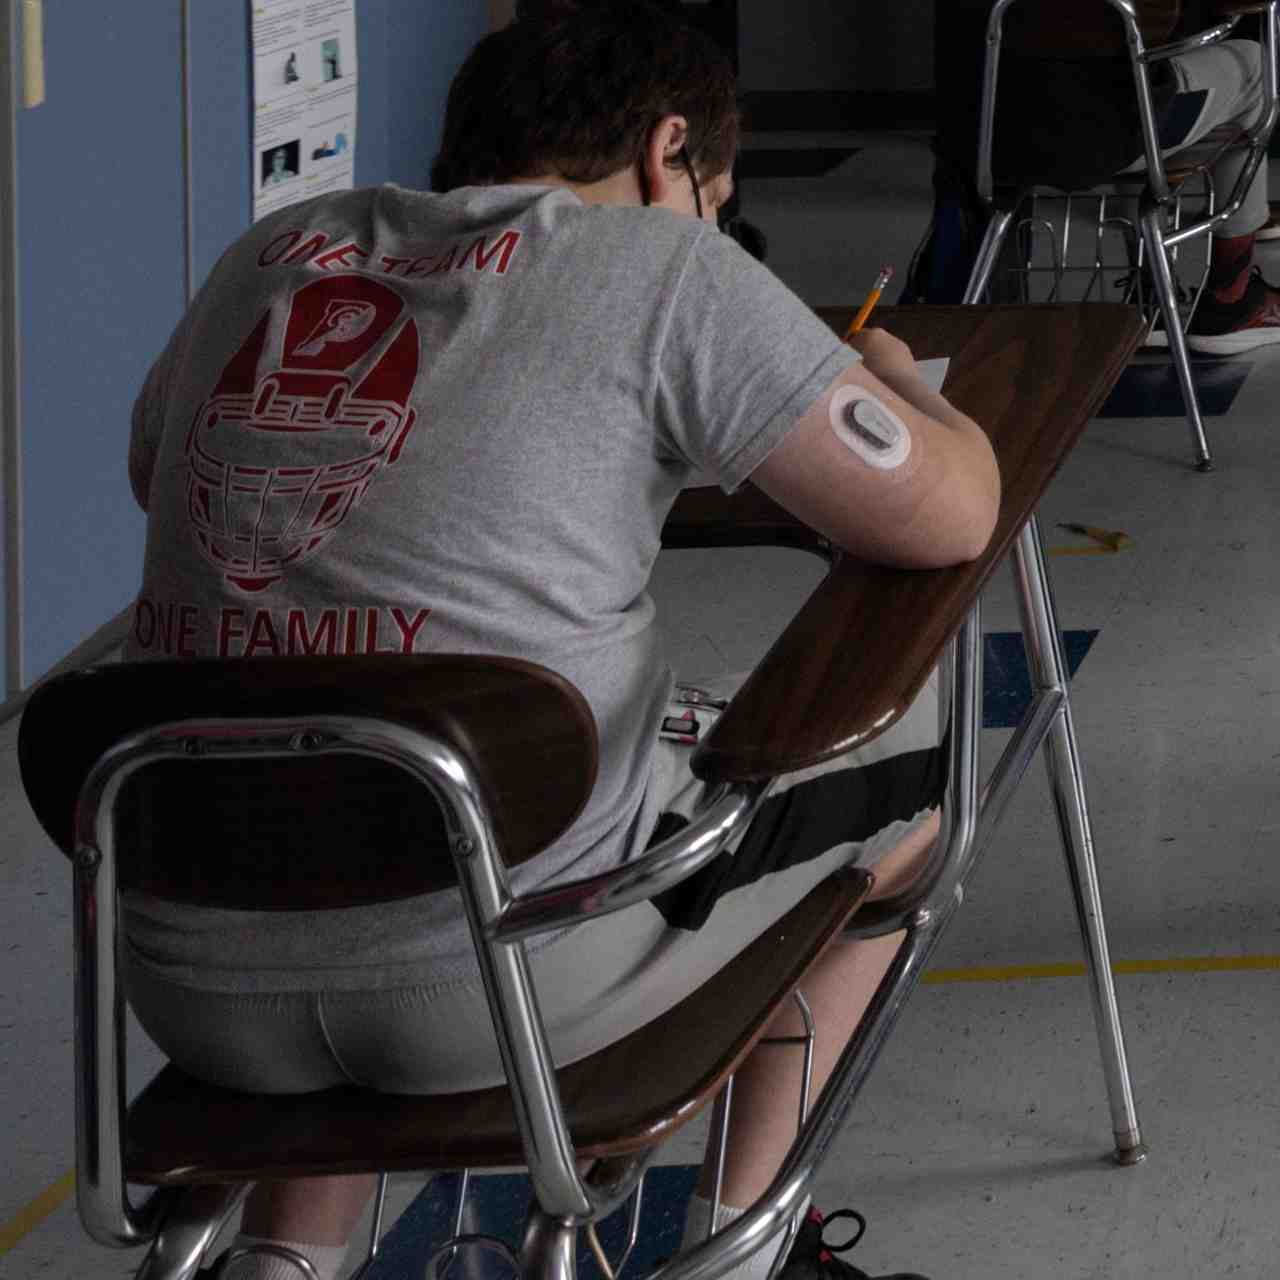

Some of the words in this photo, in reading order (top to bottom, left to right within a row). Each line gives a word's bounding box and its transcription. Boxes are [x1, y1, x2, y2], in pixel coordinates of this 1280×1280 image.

[258, 229, 370, 271] ONE
[380, 228, 522, 276] TEAM
[134, 599, 199, 660] ONE
[217, 606, 433, 658] FAMILY
